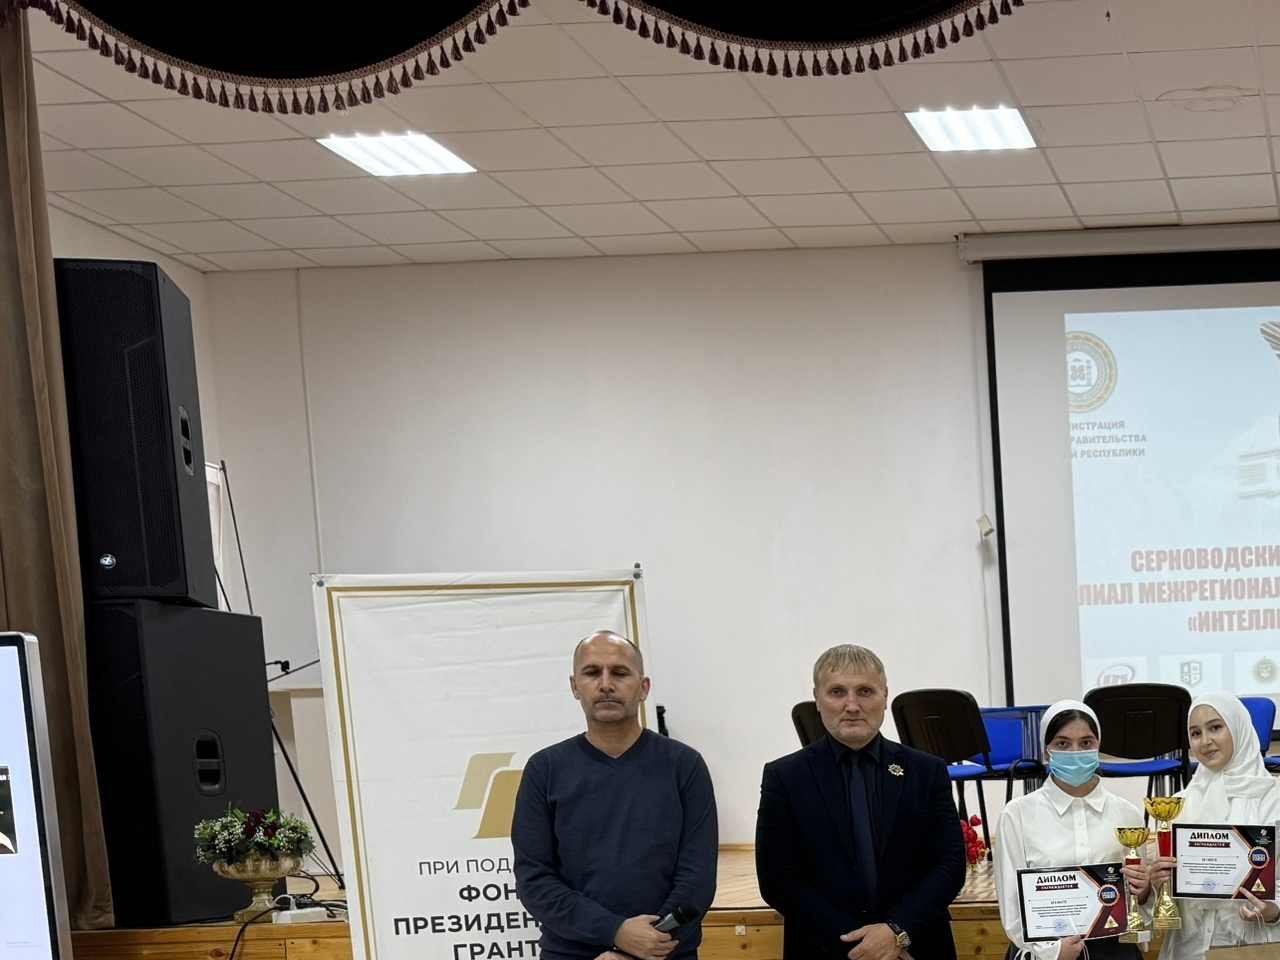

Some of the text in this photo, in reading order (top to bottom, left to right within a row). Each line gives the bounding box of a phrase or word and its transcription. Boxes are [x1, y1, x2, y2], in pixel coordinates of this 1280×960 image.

[1080, 448, 1145, 459] РЕСПУБЛИКИ
[1190, 831, 1229, 840] ДИПЛОМ
[418, 860, 459, 875] ПРИ
[1036, 874, 1077, 884] ДИПЛОМ
